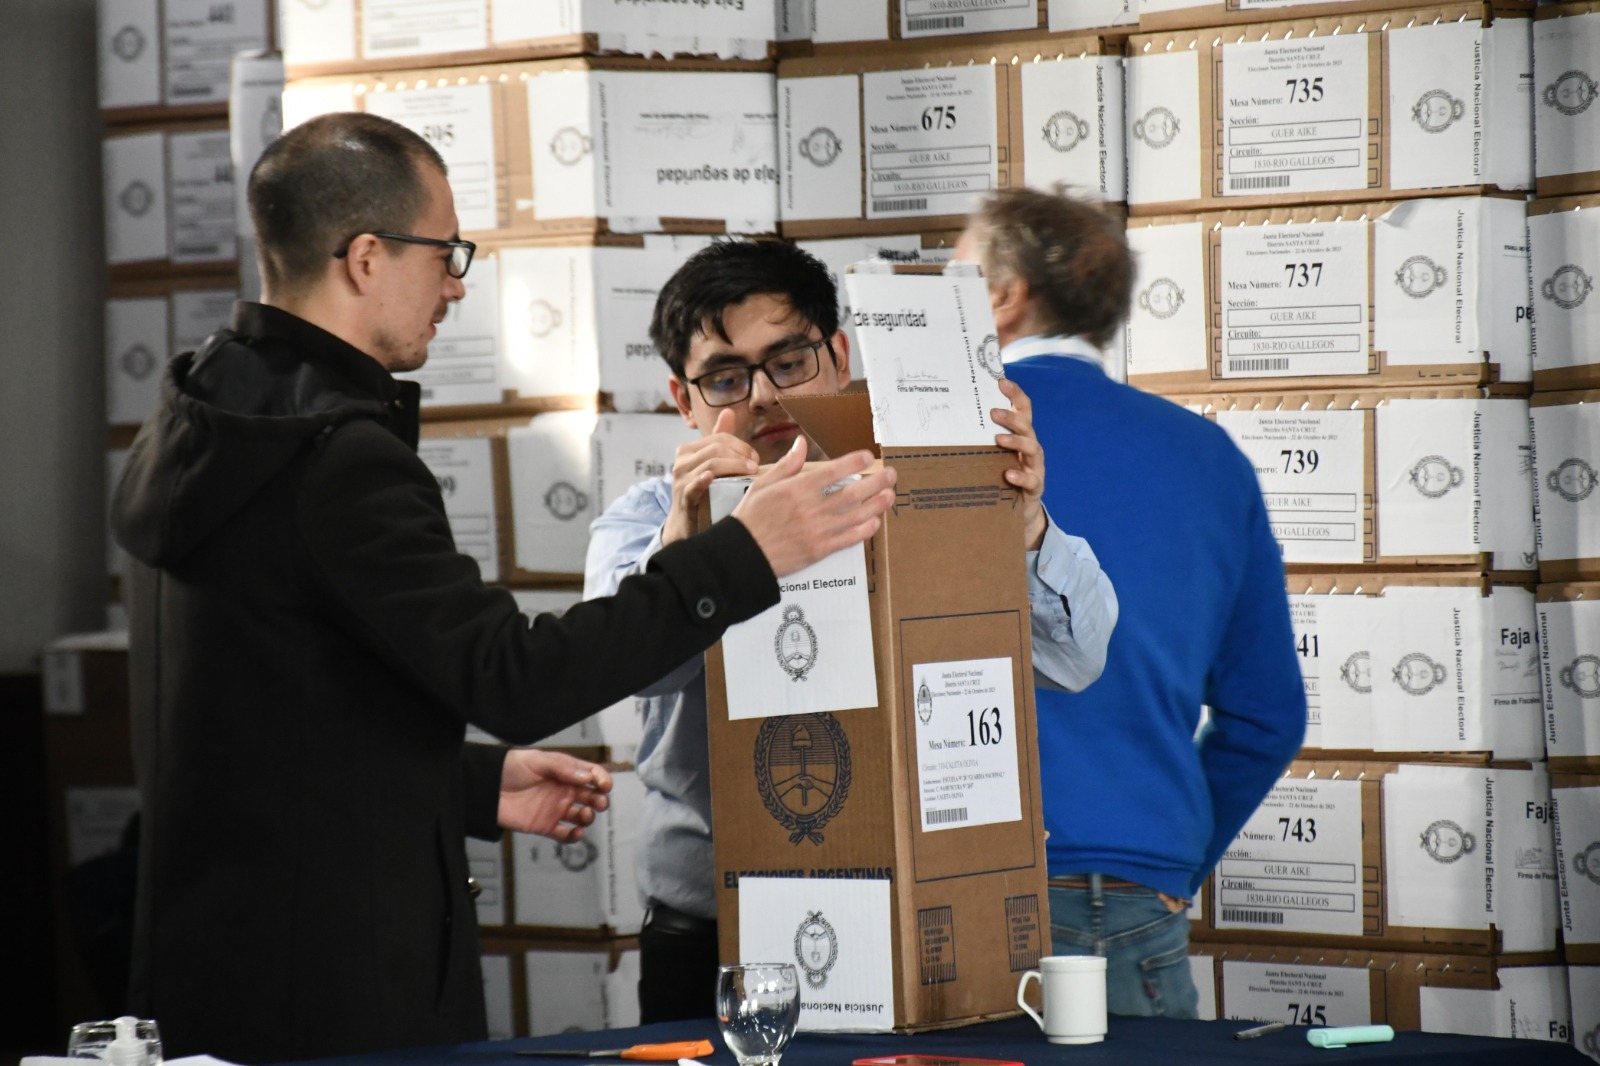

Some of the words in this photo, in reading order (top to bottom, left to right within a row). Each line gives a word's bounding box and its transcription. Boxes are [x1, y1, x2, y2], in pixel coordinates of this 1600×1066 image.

[1303, 45, 1325, 53] Nacional
[1096, 65, 1104, 102] Justicia
[1230, 98, 1248, 107] Mesa
[1251, 96, 1283, 106] Número:
[1286, 77, 1324, 104] 735
[922, 106, 956, 130] 675
[1097, 105, 1106, 148] Nacional
[1271, 128, 1294, 139] GUER
[1297, 127, 1317, 136] AIKE
[1289, 156, 1335, 166] GALLEGOS
[1473, 131, 1481, 176] Electoral
[656, 164, 729, 186] seguridad
[733, 167, 750, 184] de
[1098, 150, 1108, 193] Electoral
[1456, 210, 1464, 249] Justicia
[1228, 281, 1247, 291] Mesa
[1250, 280, 1282, 289] Número:
[1285, 263, 1323, 288] 737
[1456, 252, 1464, 296] Nacional
[1228, 299, 1258, 307] Sección:
[873, 309, 927, 331] seguridad
[1270, 312, 1294, 321] GUER
[1296, 311, 1317, 320] AIKE
[1455, 299, 1463, 344] Electoral
[1228, 330, 1261, 338] Circuito:
[1253, 342, 1287, 351] 1830-RIO
[1289, 340, 1335, 350] GALLEGOS
[1473, 411, 1482, 450] Justicia
[635, 460, 665, 477] Faja
[1280, 449, 1319, 474] 739
[1473, 453, 1481, 497] Nacional
[1266, 498, 1289, 507] GUER
[1291, 498, 1312, 507] AIKE
[1284, 528, 1330, 536] GALLEGOS
[1473, 500, 1481, 544] Electoral
[780, 578, 809, 593] cional
[813, 576, 856, 590] Electoral
[1453, 608, 1461, 646] Justicia
[1501, 628, 1530, 649] Faja
[1540, 612, 1549, 659] Nacional
[1293, 633, 1319, 657] 41
[1455, 650, 1465, 693] Nacional
[1305, 682, 1317, 691] KE
[1543, 665, 1554, 711] Electoral
[929, 740, 942, 749] Mesa
[967, 707, 1002, 746] 163
[1548, 713, 1556, 744] Junta
[1486, 778, 1494, 817] Justicia
[1243, 831, 1276, 841] Número:
[1278, 817, 1317, 843] 743
[1552, 798, 1562, 846] Nacional
[1486, 820, 1494, 864] Nacional
[1265, 865, 1288, 875] GUER
[1291, 866, 1311, 876] AIKE
[1557, 851, 1568, 897] Electoral
[1222, 879, 1255, 888] Circuito:
[1485, 867, 1494, 912] Electoral
[1247, 893, 1281, 904] 1830-RIO
[1283, 896, 1329, 906] GALLEGOS
[1563, 901, 1572, 931] Junta
[801, 1003, 841, 1013] Naciona
[845, 1003, 884, 1014] Justicia
[1288, 1004, 1327, 1026] 745
[1549, 1021, 1571, 1042] Faj
